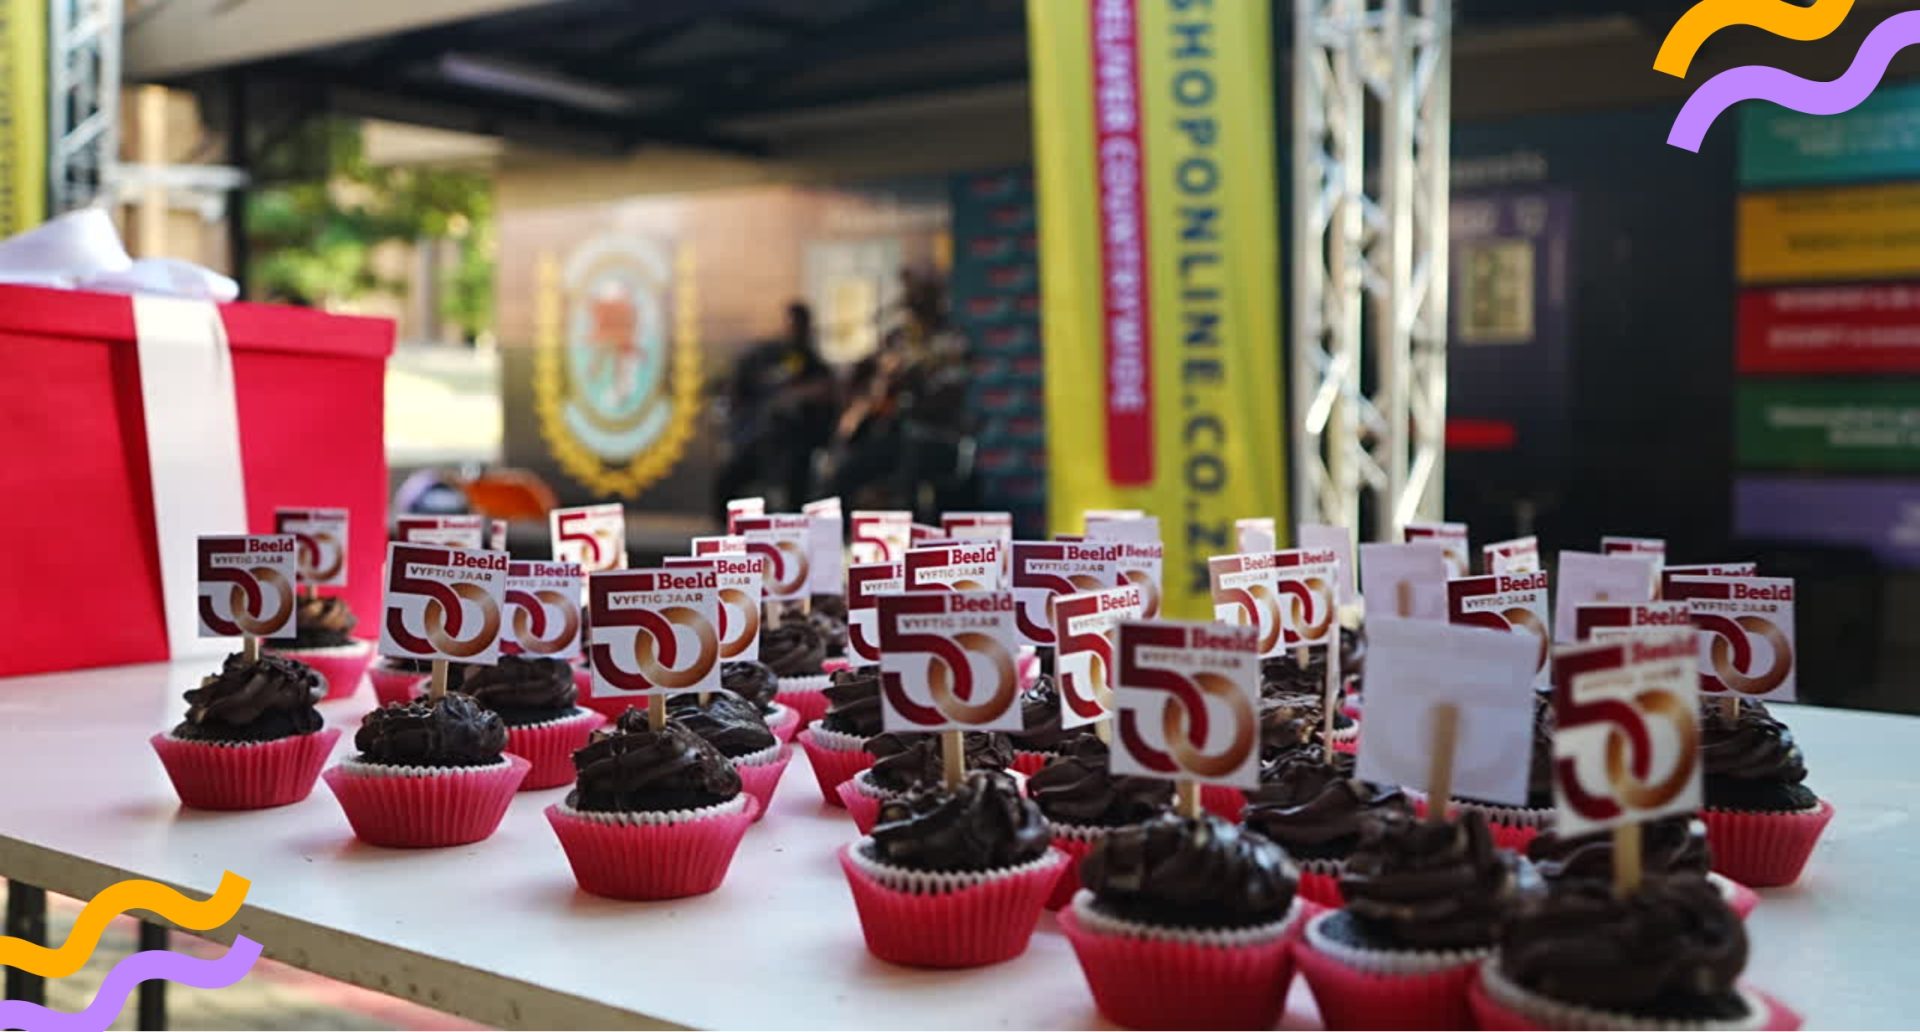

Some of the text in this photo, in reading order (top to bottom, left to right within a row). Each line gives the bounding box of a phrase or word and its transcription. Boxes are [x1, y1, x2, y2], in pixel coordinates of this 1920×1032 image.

[1102, 138, 1146, 413] COUNTRYWIDE
[248, 539, 294, 552] Beeld
[1068, 546, 1117, 561] Beeld
[1126, 546, 1162, 558] Beeld
[452, 551, 507, 570] Beeld
[952, 547, 996, 564] Beeld
[1243, 556, 1275, 570] Beeld
[1302, 551, 1334, 565] Beeld
[410, 566, 493, 582] VYFTIG JAAR
[717, 559, 763, 574] Beeld
[1030, 562, 1105, 572] VYFTIG JAAR
[198, 539, 293, 636] 50
[657, 572, 717, 589] Beeld
[1500, 573, 1548, 593] Beeld
[613, 592, 704, 605] VYFTIG JAAR
[1100, 590, 1140, 611] Beeld
[1734, 583, 1793, 601] Beeld
[387, 546, 500, 657] 50
[951, 592, 1013, 612] Beeld
[1465, 597, 1504, 608] VYFTIG
[1691, 602, 1778, 613] VYFTIG JAAR
[902, 619, 955, 629] VYFTIG
[1635, 607, 1689, 626] Beeld
[589, 574, 718, 691] 50
[879, 595, 1017, 726] 50
[1119, 625, 1257, 777] 50
[1555, 643, 1697, 820] 50
